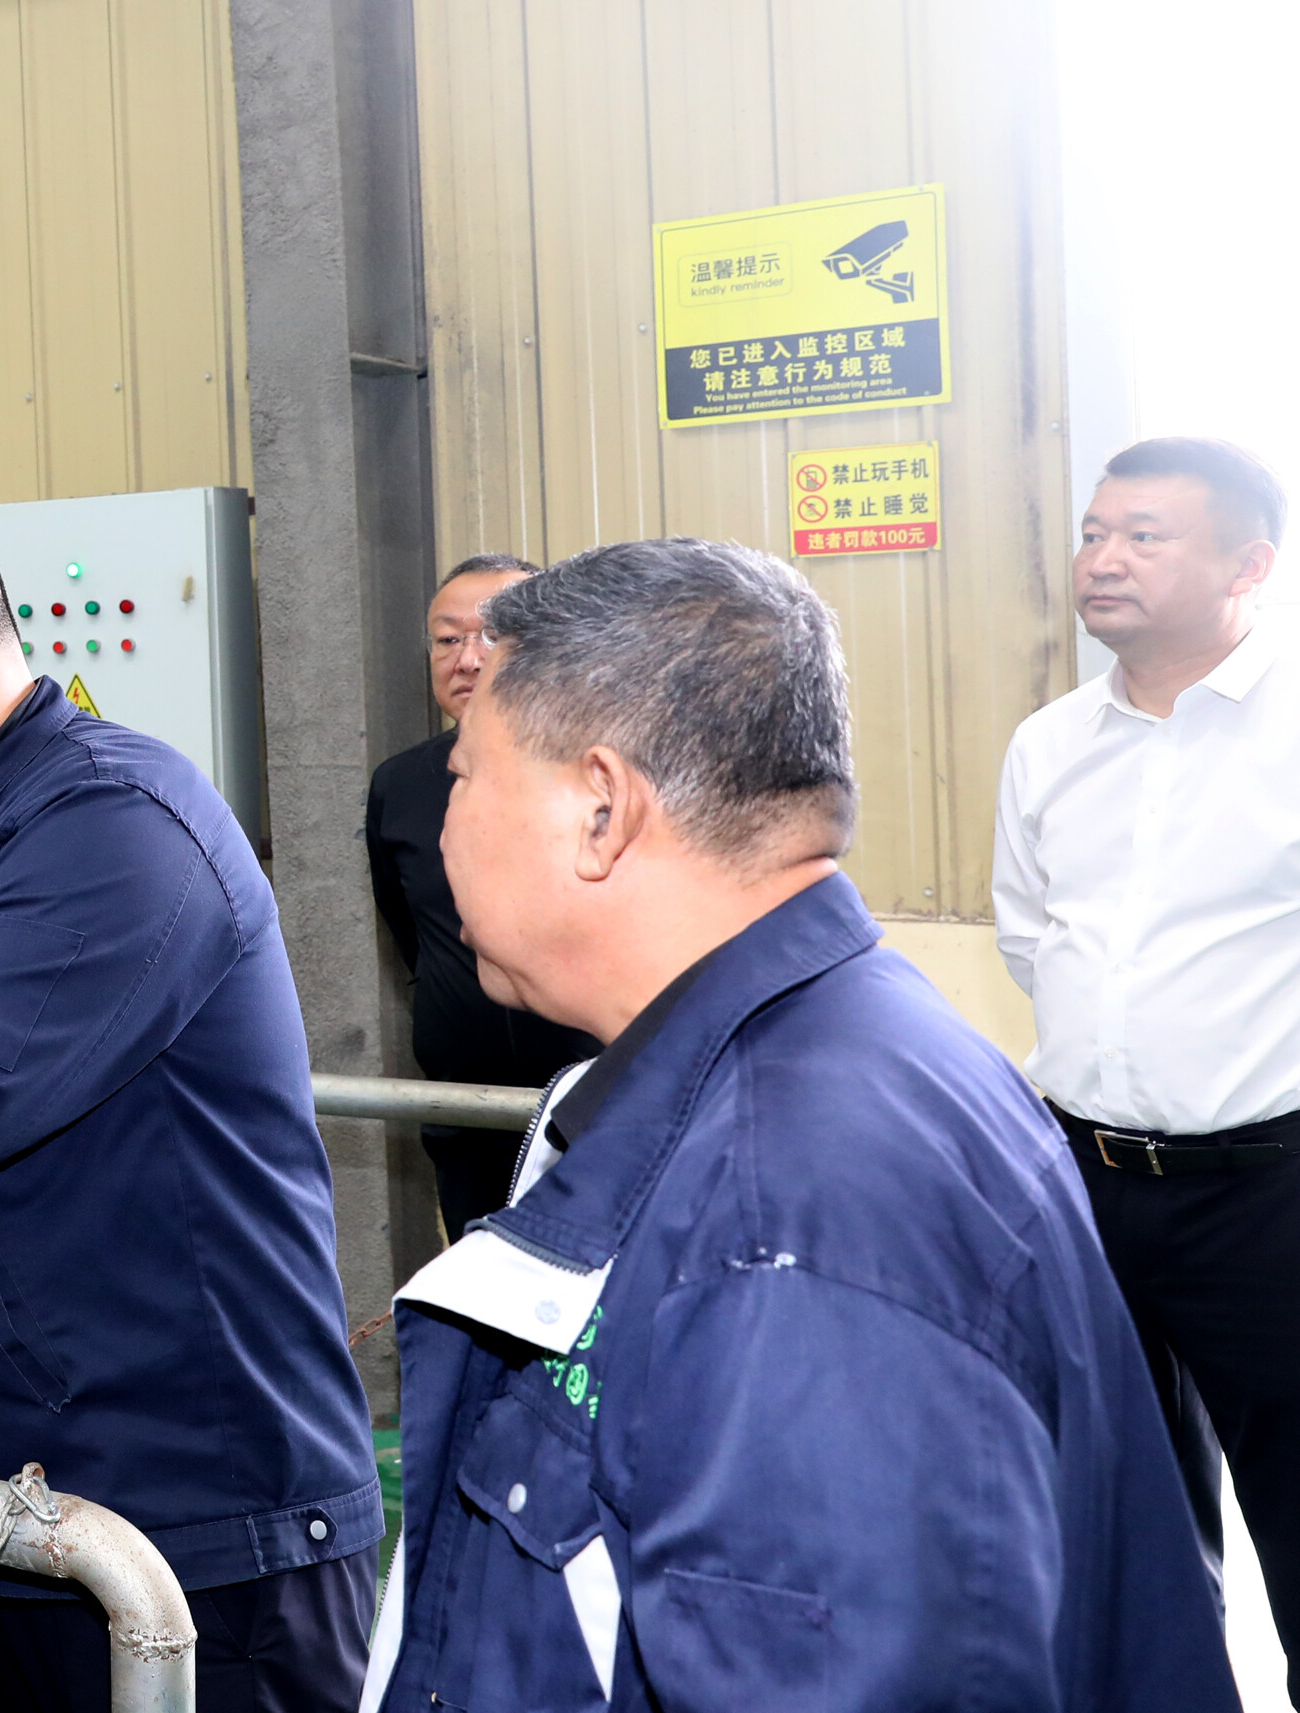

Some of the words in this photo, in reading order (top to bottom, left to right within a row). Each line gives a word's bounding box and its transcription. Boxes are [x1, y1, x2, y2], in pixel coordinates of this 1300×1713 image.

[691, 253, 780, 283] 温馨提示
[691, 285, 726, 297] kindly
[730, 278, 785, 292] reminder
[690, 326, 905, 369] 您已进入监控区域
[703, 353, 892, 391] 请注意行为规范
[693, 406, 724, 415] Please
[726, 404, 744, 413] pay
[746, 398, 791, 410] attention
[793, 397, 804, 405] to
[806, 395, 823, 404] the
[824, 392, 850, 402] code
[852, 390, 863, 399] of
[865, 387, 907, 398] conduct
[705, 394, 725, 403] You
[726, 392, 750, 400] have
[752, 386, 790, 398] entered
[792, 385, 809, 394] the
[810, 380, 868, 392] monitoring
[869, 378, 892, 387] area
[832, 458, 929, 485] 禁止玩手机
[834, 492, 928, 519] 禁止睡觉
[808, 527, 926, 550] 违者罚款100元
